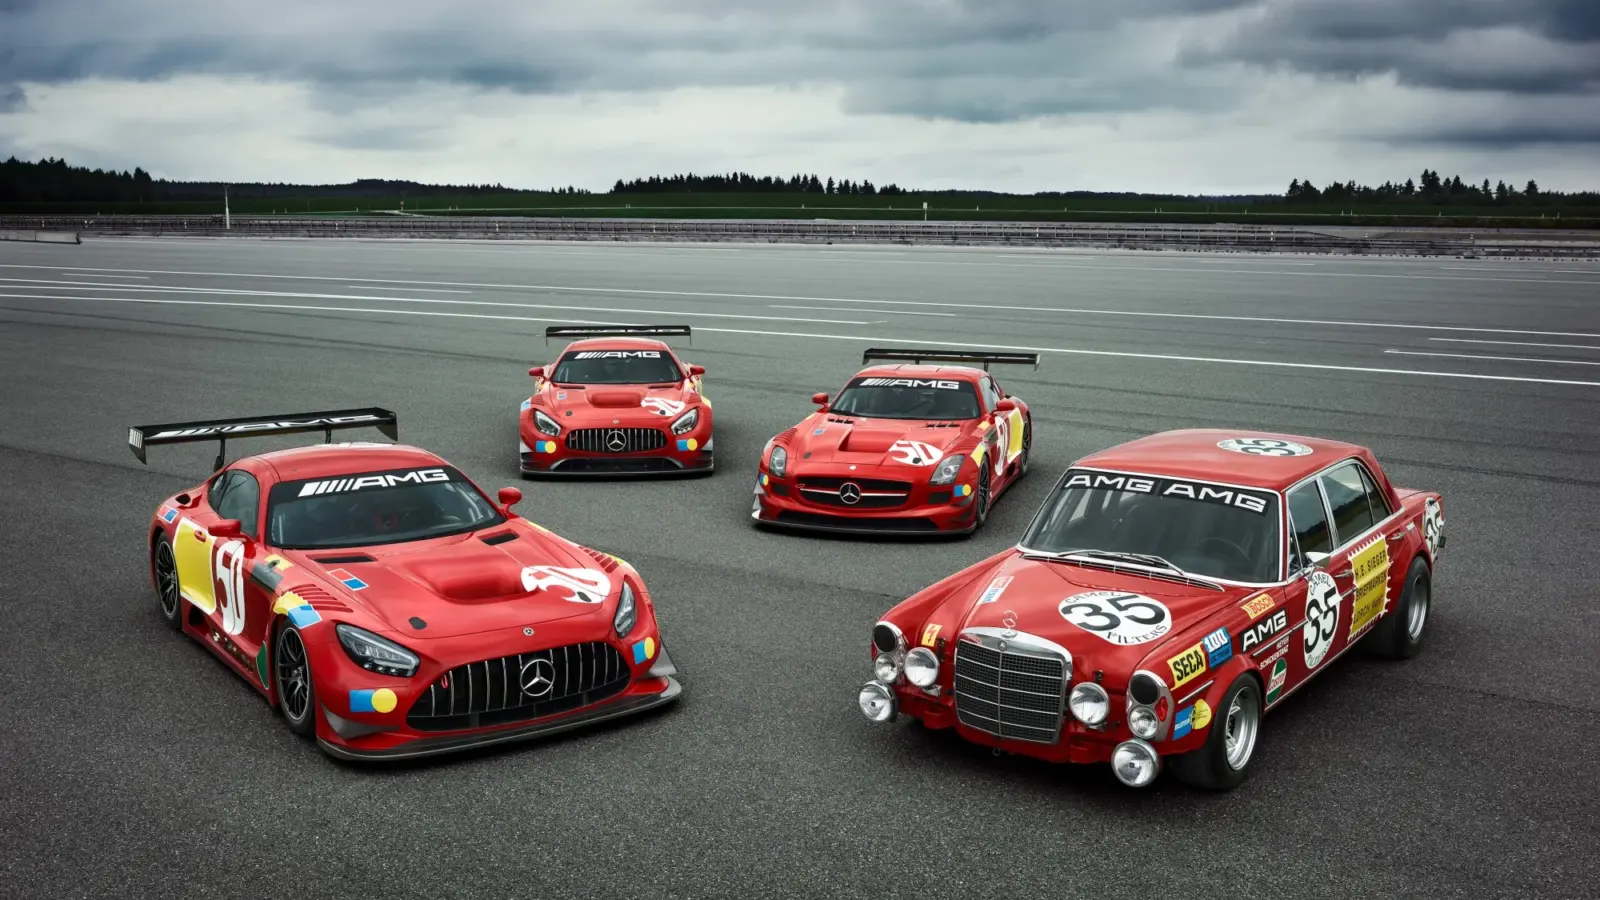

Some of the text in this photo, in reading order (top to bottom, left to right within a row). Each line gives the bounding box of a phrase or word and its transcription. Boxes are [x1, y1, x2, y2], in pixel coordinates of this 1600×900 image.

[602, 351, 661, 359] AMG
[891, 379, 959, 390] AMG
[888, 439, 944, 466] 50
[351, 469, 450, 490] AMG
[1065, 474, 1267, 513] AMG AMG
[215, 541, 245, 635] 50
[1065, 591, 1121, 604] CAMEL
[1061, 594, 1166, 632] 35
[1248, 595, 1275, 614] BOSCH
[1242, 610, 1287, 652] AMG
[1304, 586, 1338, 654] 35
[1107, 625, 1168, 643] FILTERS
[1172, 649, 1204, 682] SECA
